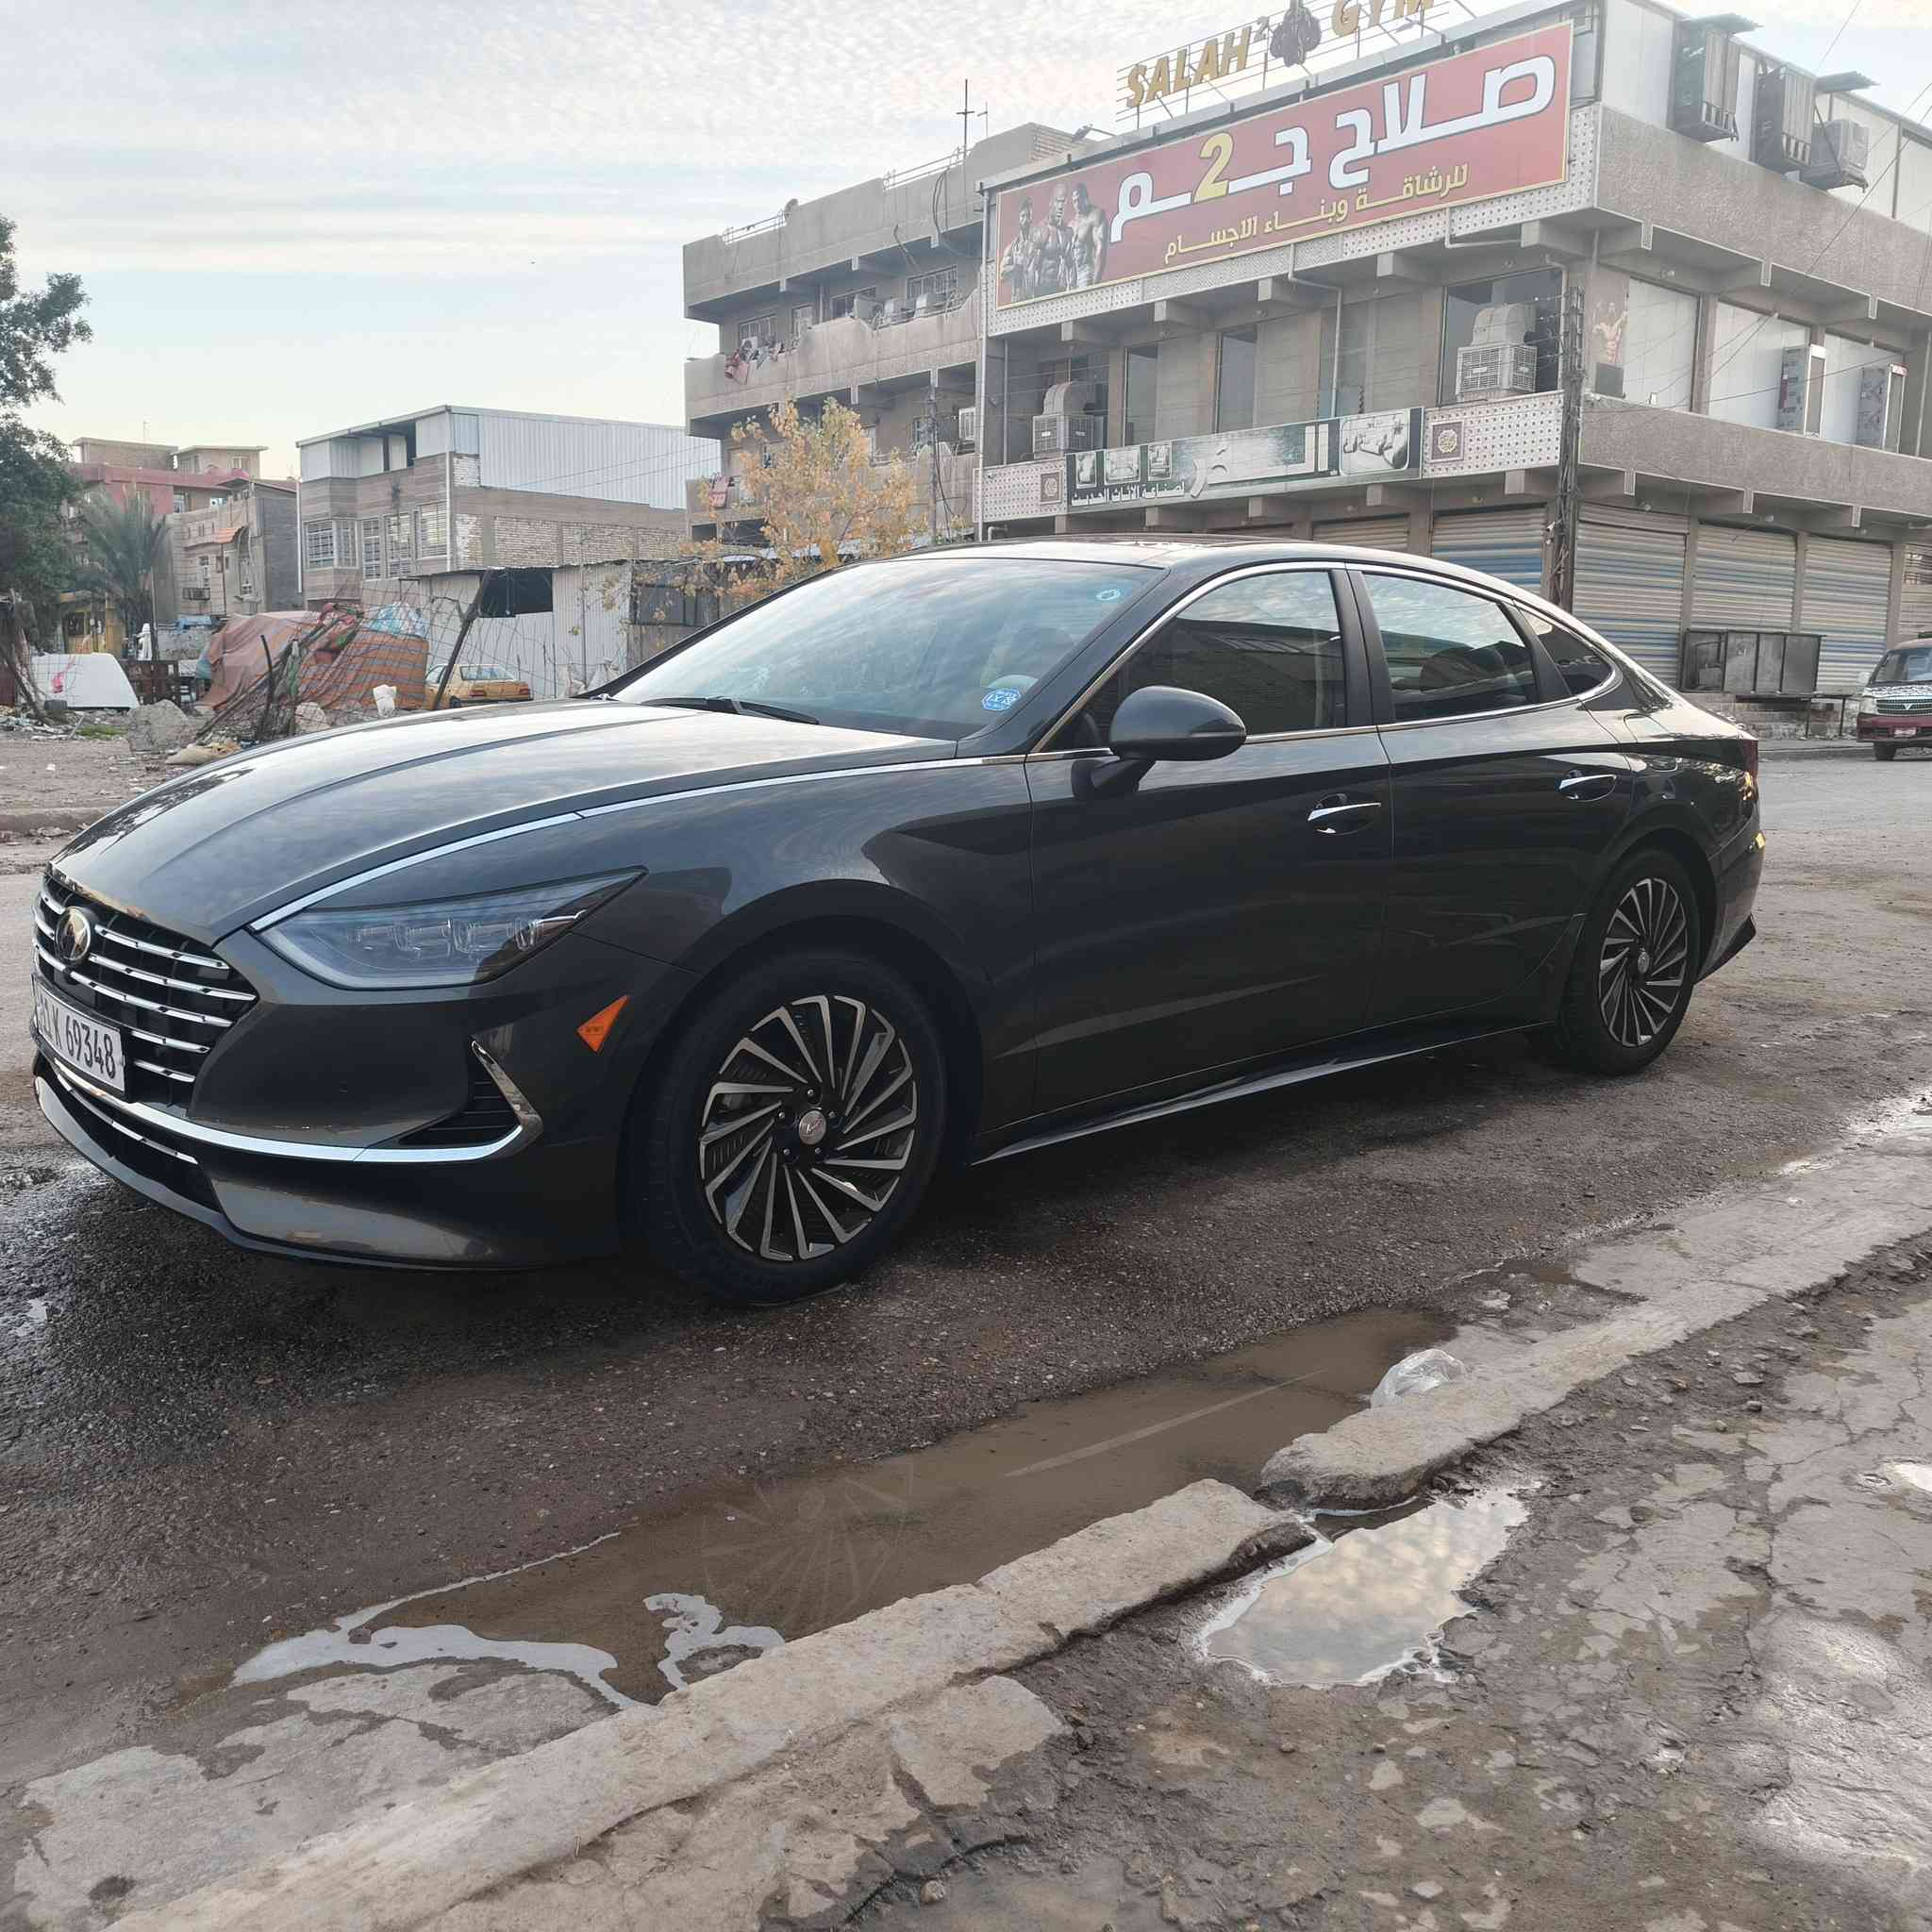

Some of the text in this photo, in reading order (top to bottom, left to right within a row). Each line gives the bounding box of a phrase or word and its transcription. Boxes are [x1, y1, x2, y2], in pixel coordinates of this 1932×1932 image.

[1328, 55, 1556, 190] صلاح
[1165, 162, 1469, 264] للرشاقة وبناء الاجسام
[65, 1015, 115, 1079] 69348
